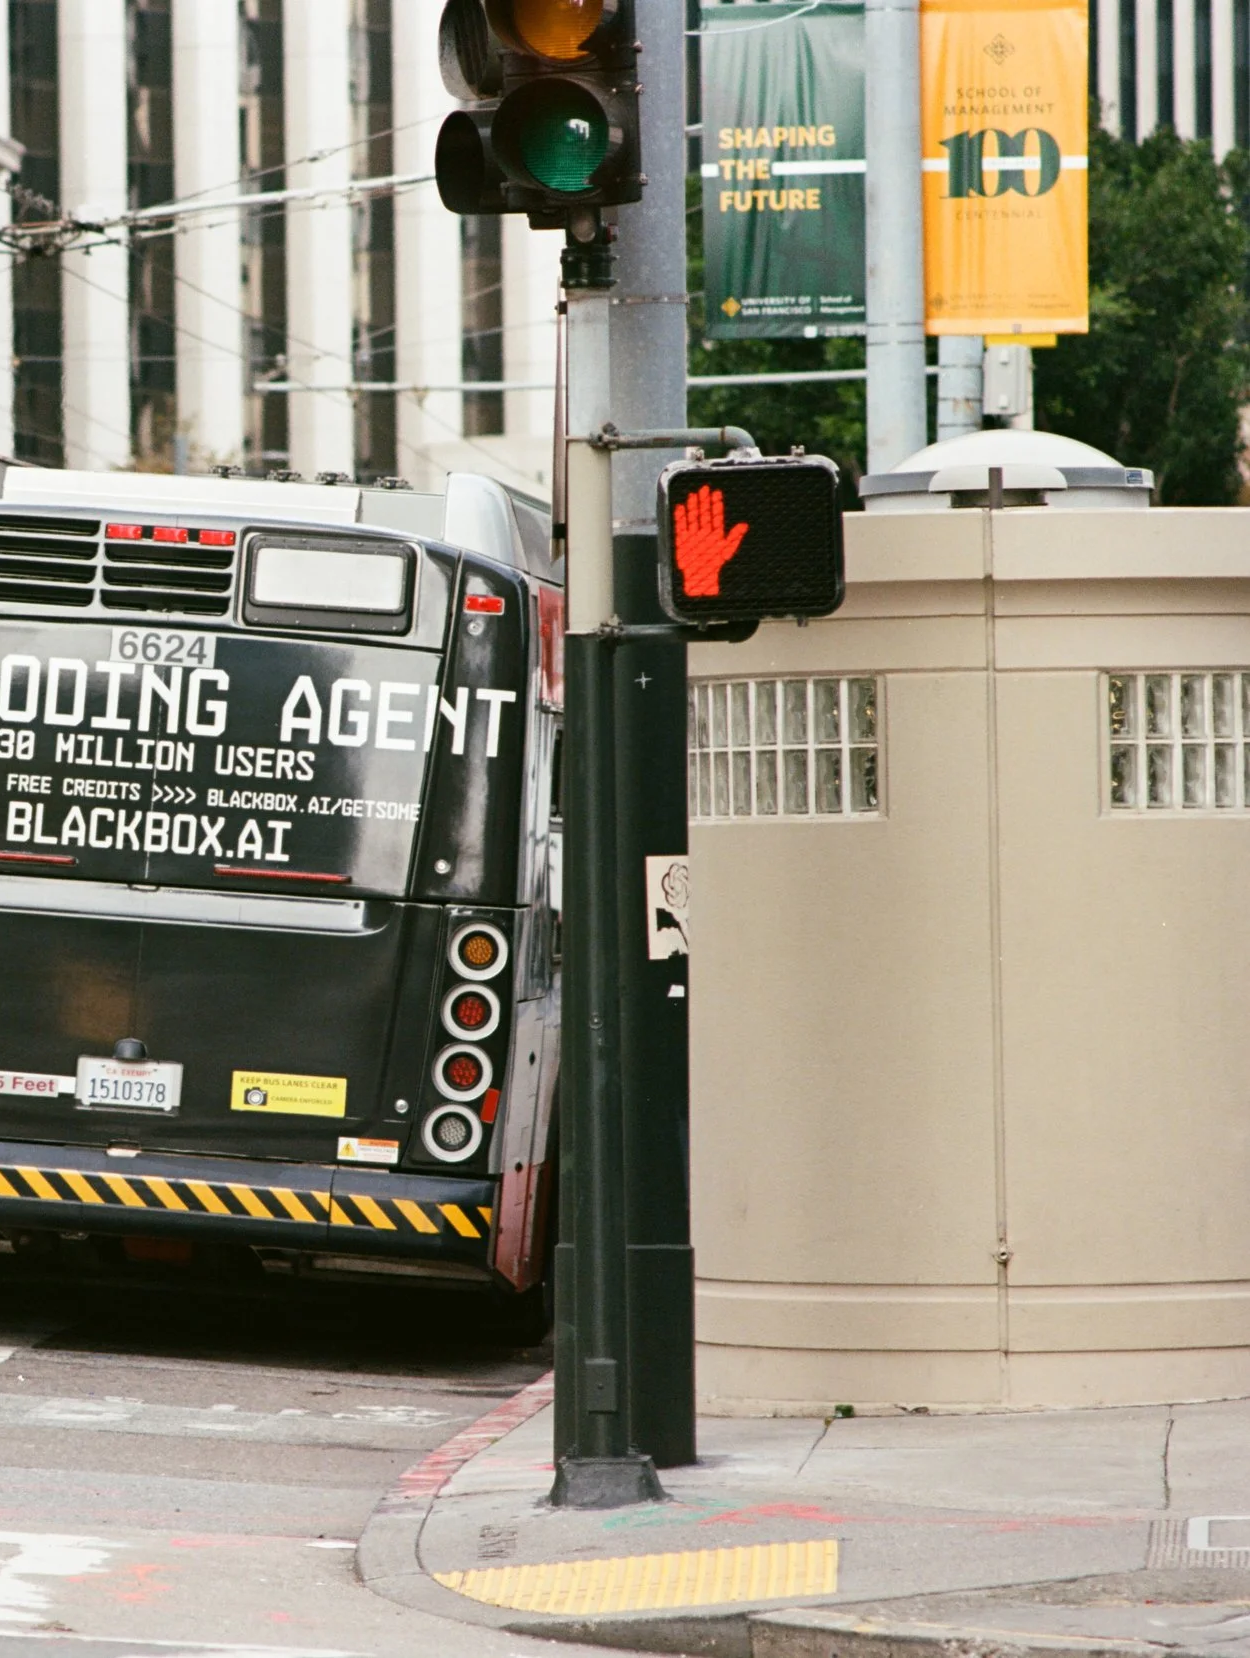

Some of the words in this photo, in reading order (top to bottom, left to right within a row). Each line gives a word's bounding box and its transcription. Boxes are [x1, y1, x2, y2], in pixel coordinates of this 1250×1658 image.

[956, 87, 1016, 99] SCHOOL
[1023, 86, 1042, 97] OF
[944, 103, 1054, 115] MANAGEMENT
[718, 125, 837, 150] SHAPING
[718, 158, 770, 181] THE
[938, 127, 1061, 199] 100
[718, 188, 822, 213] FUTURE
[118, 630, 208, 665] 6624
[280, 675, 517, 758] AGENT
[55, 732, 196, 774] MILLION
[215, 745, 316, 782] USERS
[6, 773, 52, 795] FREE
[62, 777, 142, 801] CREDITS
[207, 788, 422, 822] BLACKBOX.AI/GETSOME
[6, 800, 293, 863] BLACKBOX.AI
[12, 1076, 55, 1093] Feet
[88, 1077, 166, 1103] 1510378
[240, 1076, 262, 1085] KEEP
[263, 1078, 280, 1086] BUS
[282, 1080, 309, 1088] LANES
[311, 1081, 338, 1090] CLEAR
